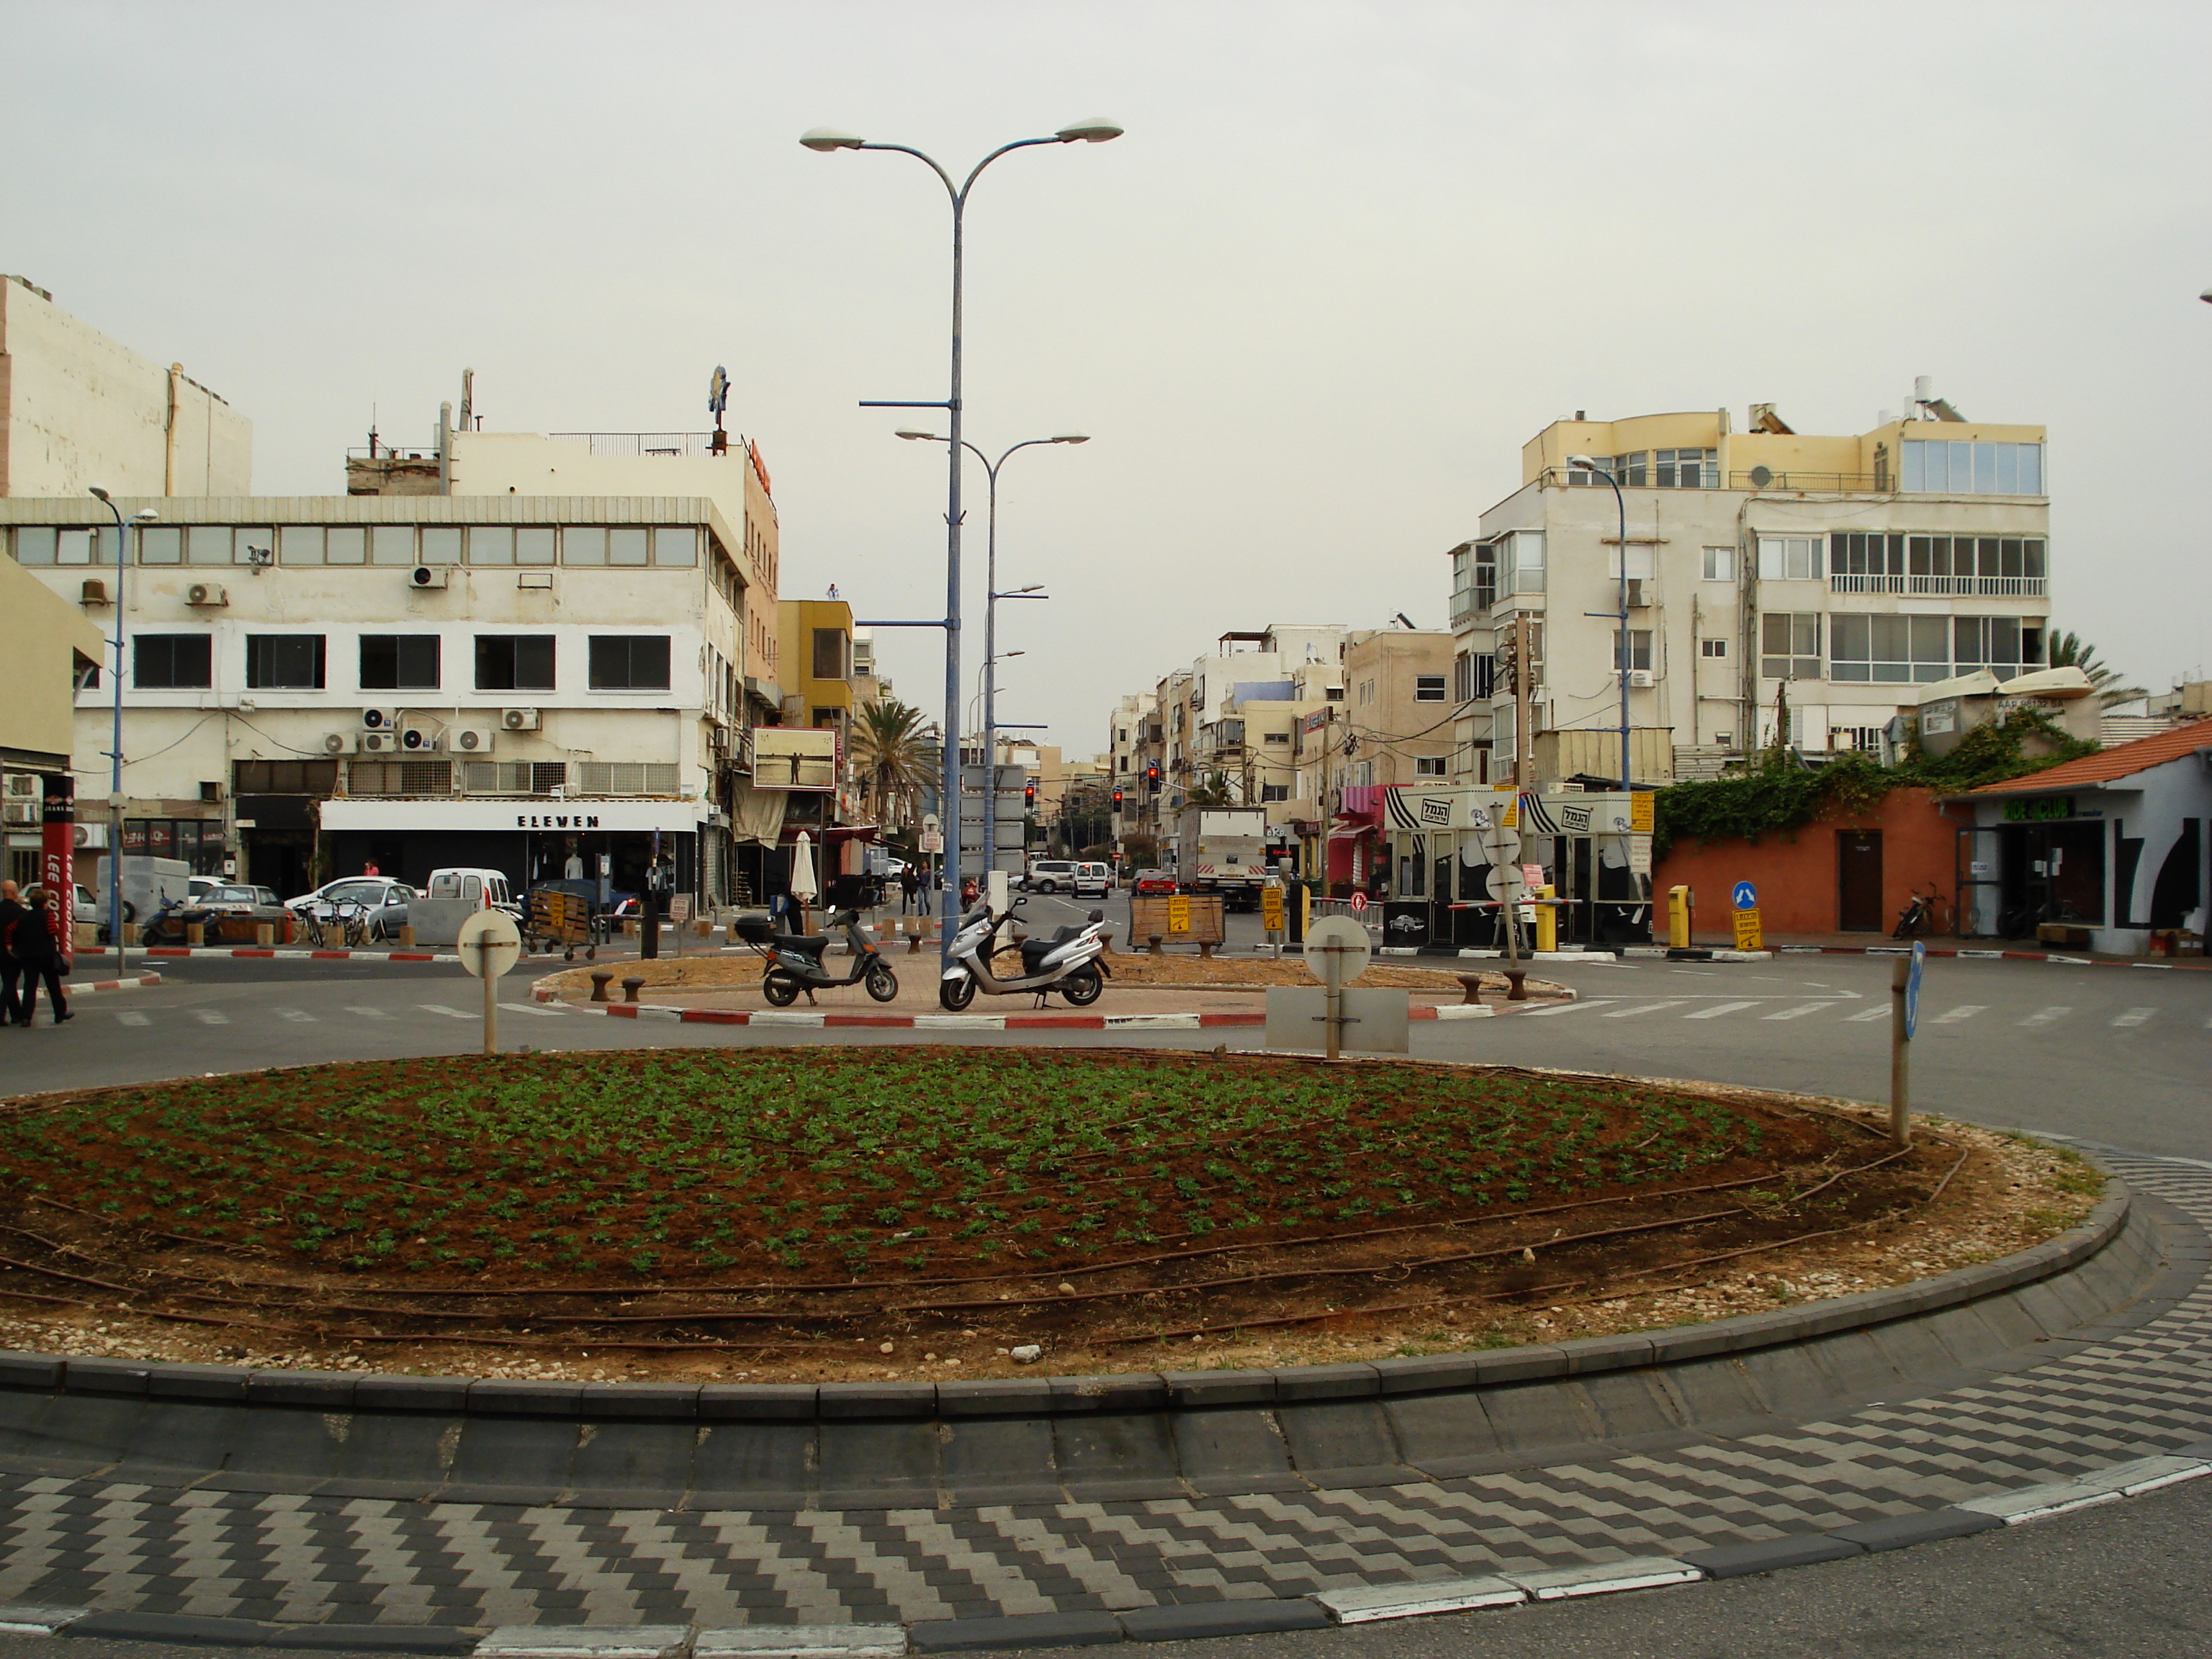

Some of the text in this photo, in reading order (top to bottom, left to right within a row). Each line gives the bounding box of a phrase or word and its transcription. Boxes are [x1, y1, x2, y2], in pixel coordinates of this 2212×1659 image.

[1424, 802, 1447, 817] הנמל
[1565, 809, 1587, 823] הנמל
[2004, 798, 2068, 819] RIDE CLUB
[517, 816, 598, 827] ELEVEN
[48, 853, 60, 884] LEE
